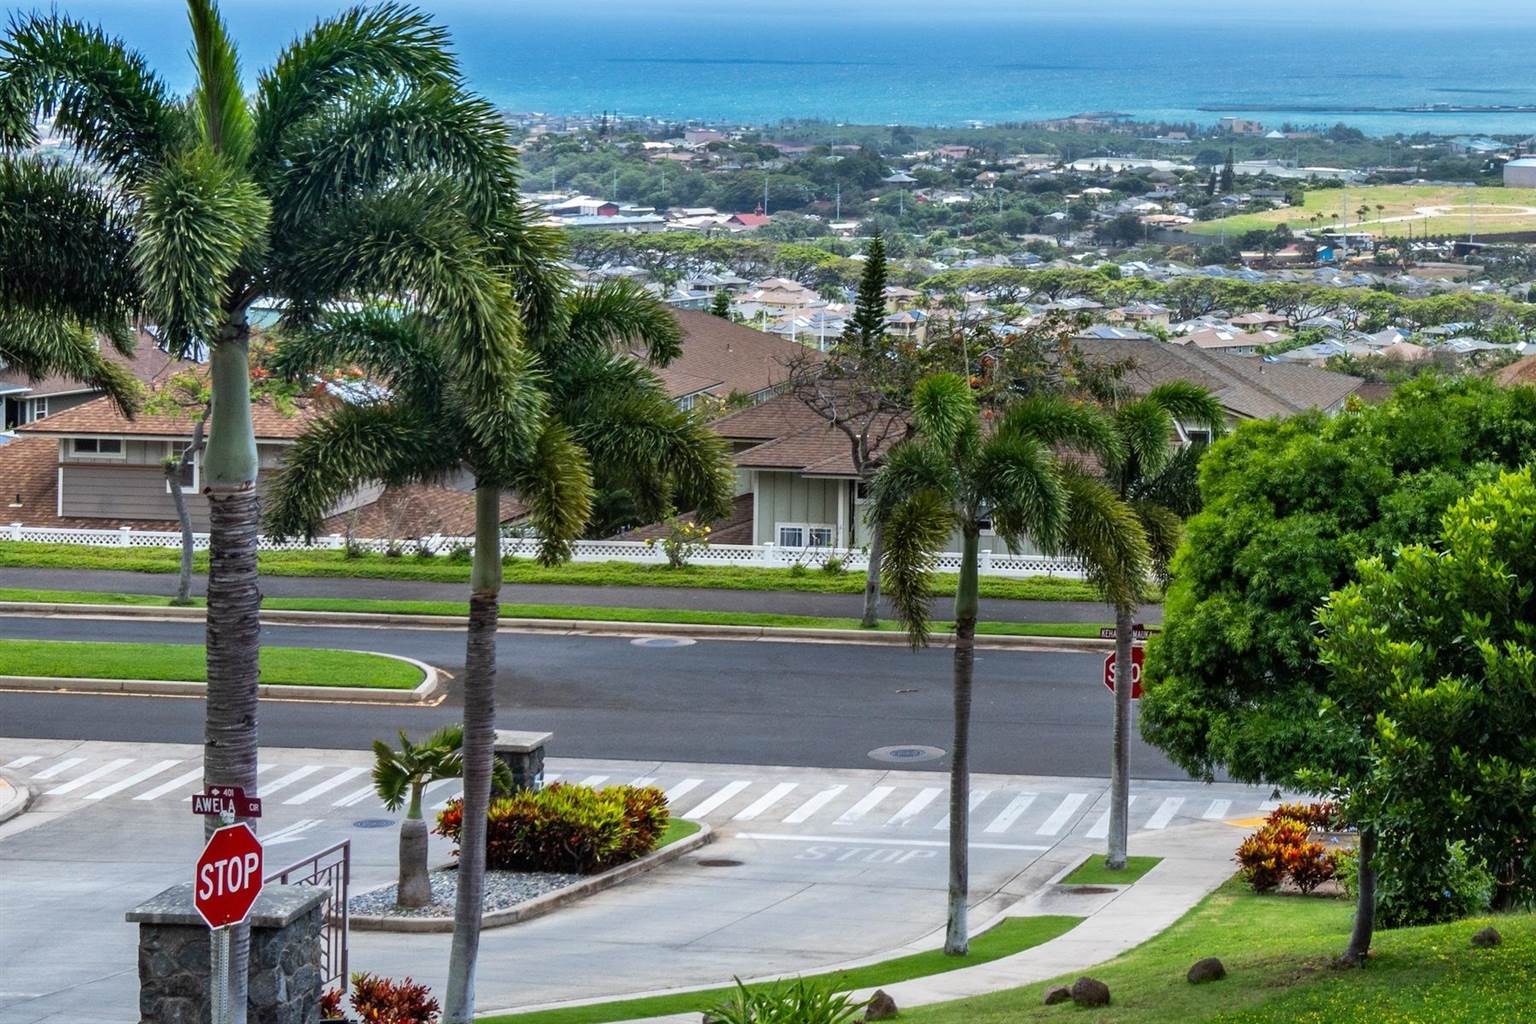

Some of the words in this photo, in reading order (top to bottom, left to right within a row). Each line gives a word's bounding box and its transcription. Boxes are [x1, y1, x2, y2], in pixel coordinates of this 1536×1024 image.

[1108, 662, 1140, 683] SO
[195, 798, 235, 813] AWELA
[249, 803, 259, 812] CIR
[794, 845, 938, 863] STOP
[199, 852, 259, 901] STOP
